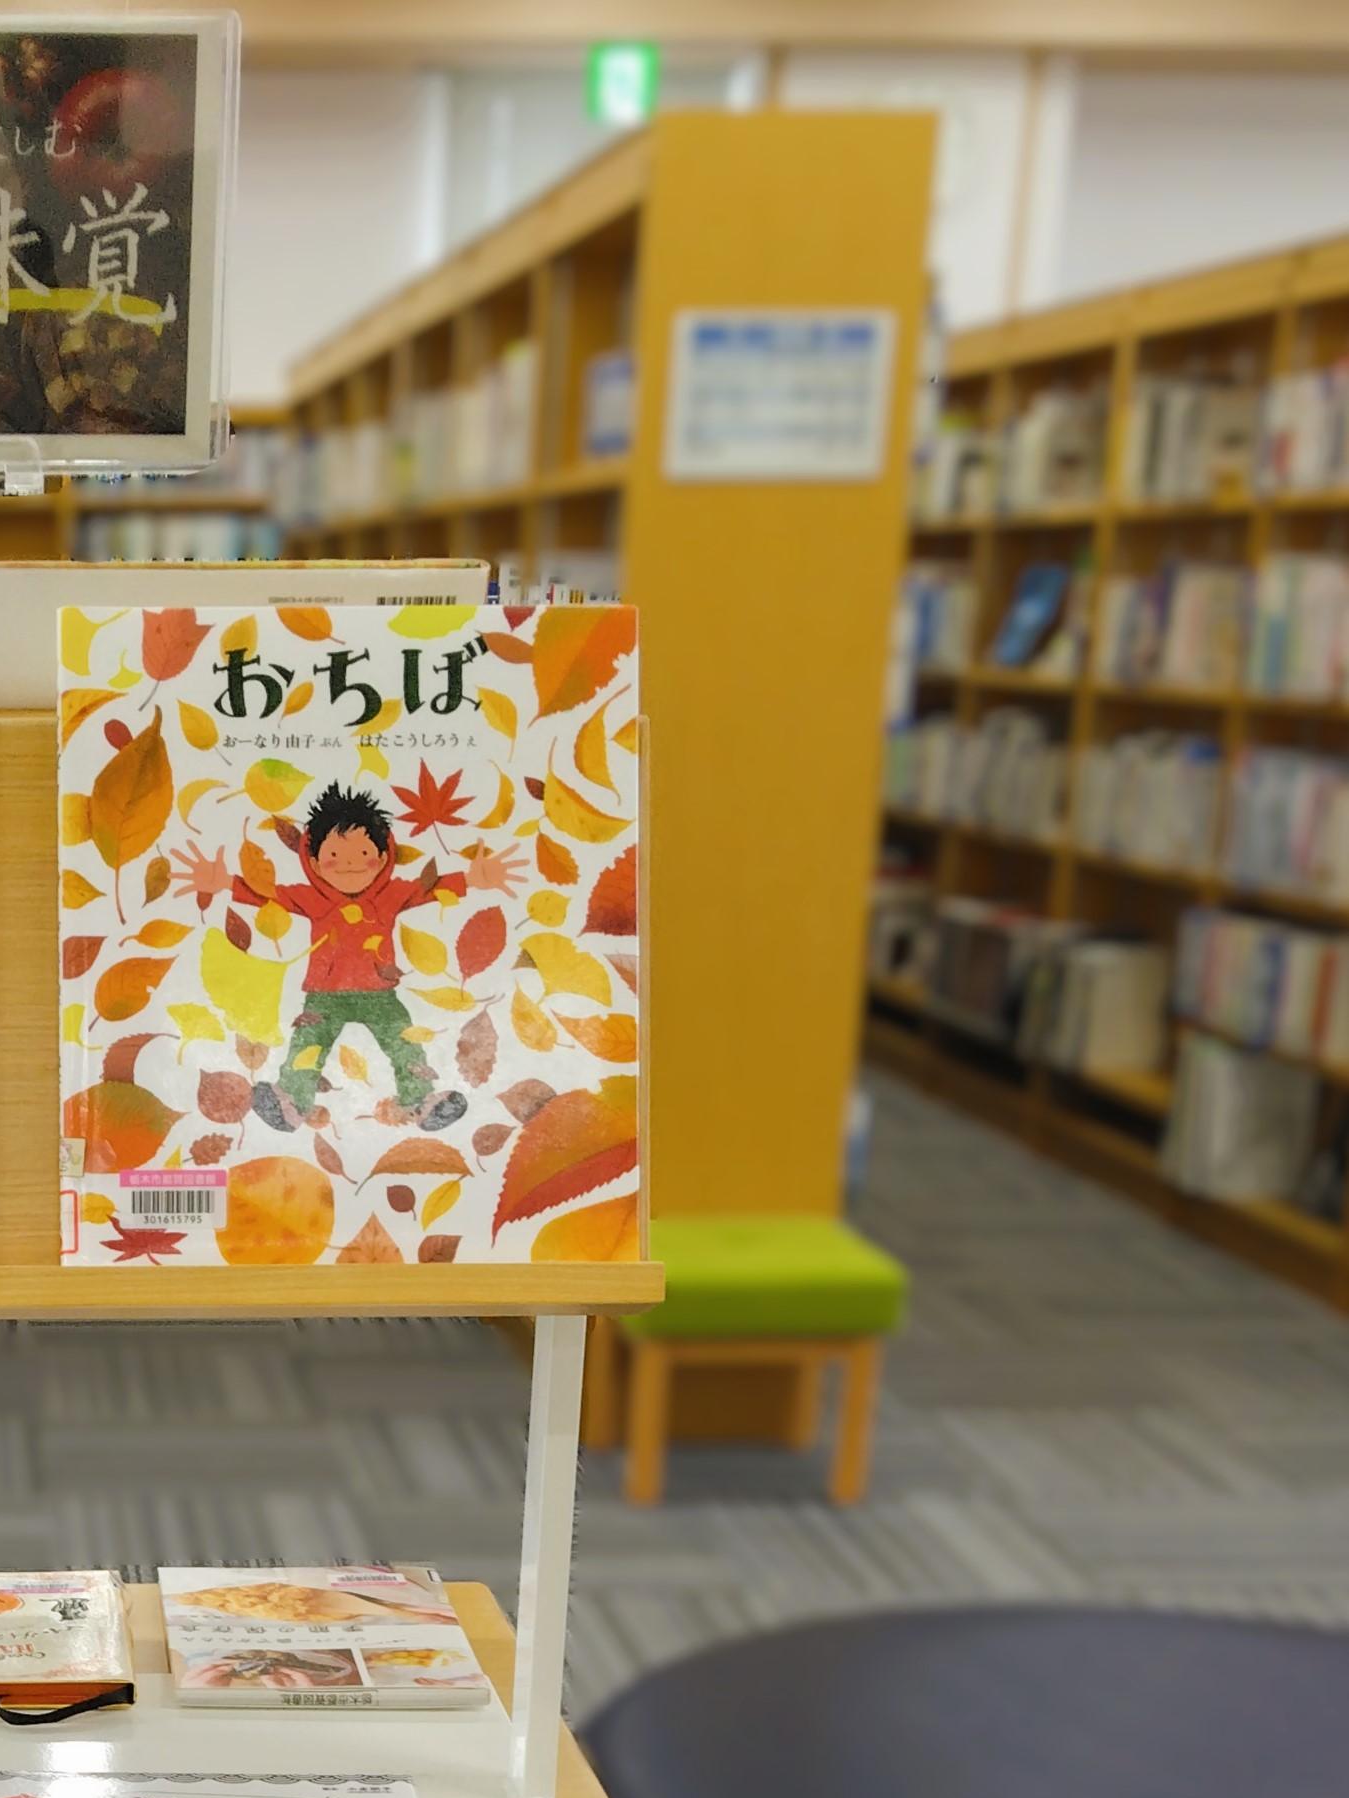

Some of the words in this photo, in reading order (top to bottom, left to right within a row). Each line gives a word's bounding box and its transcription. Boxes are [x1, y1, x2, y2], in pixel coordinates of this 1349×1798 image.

[213, 635, 489, 727] おちば
[360, 733, 460, 748] はたこうしろう
[144, 1215, 202, 1224] 301615795
